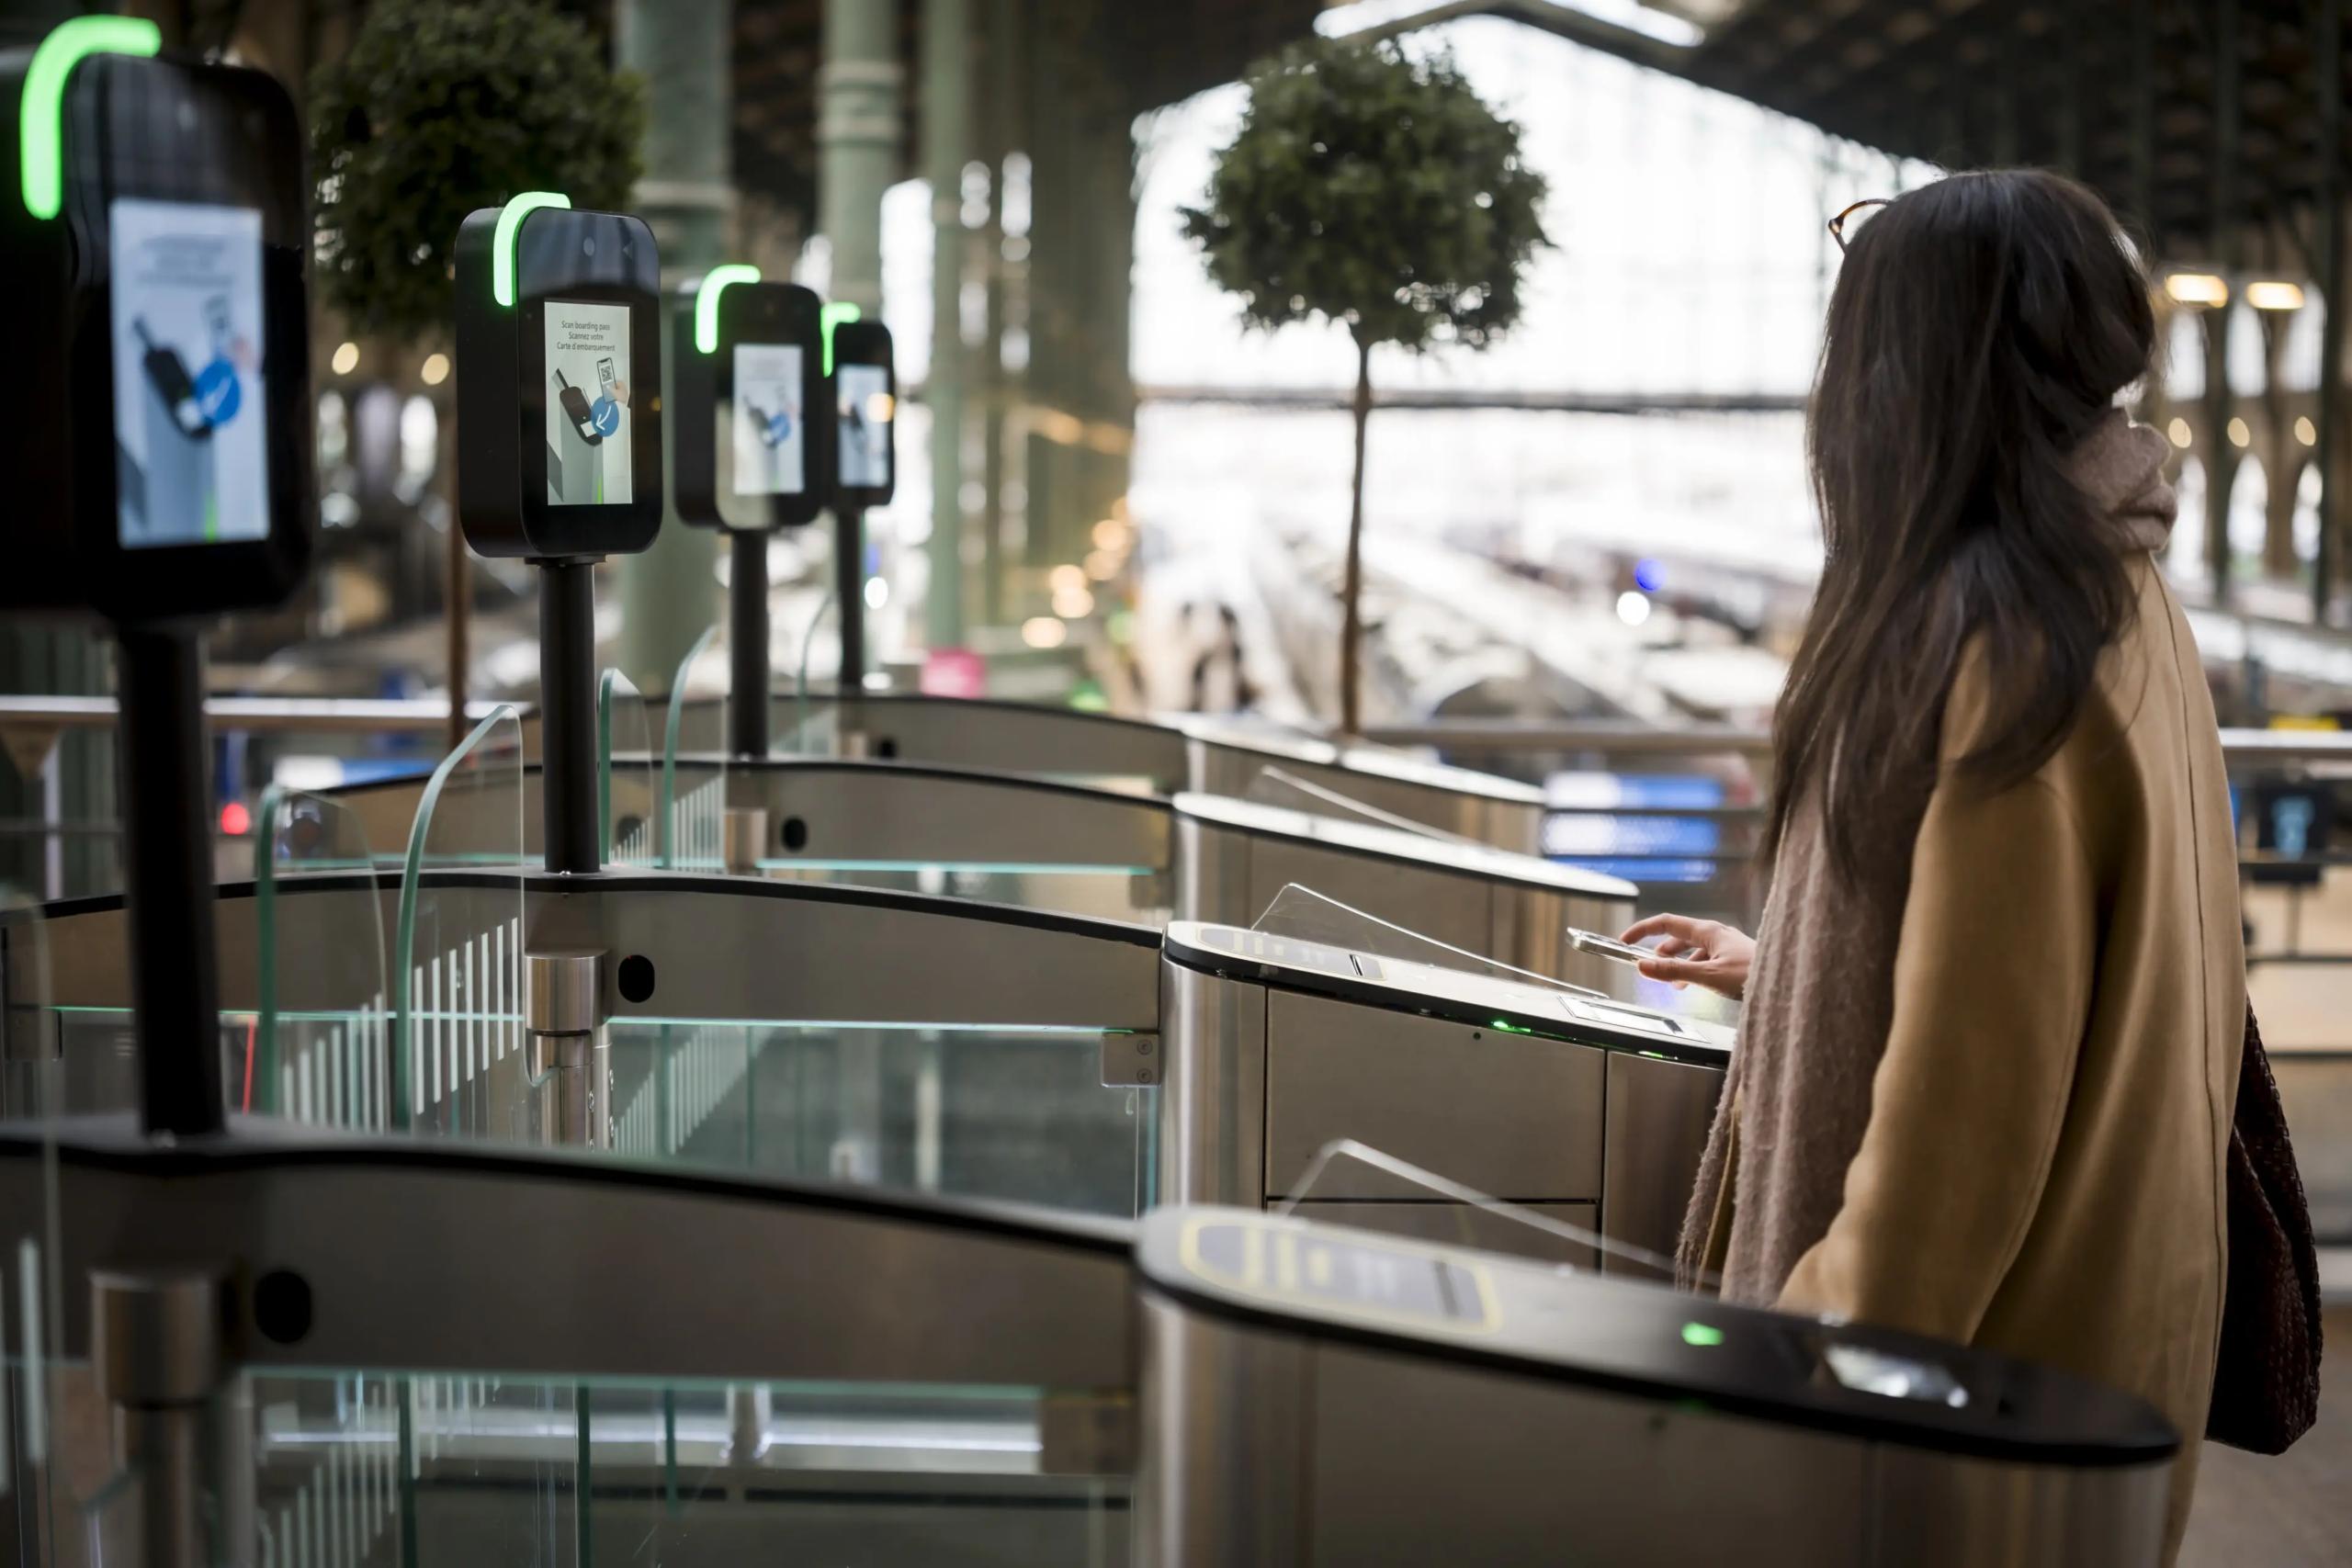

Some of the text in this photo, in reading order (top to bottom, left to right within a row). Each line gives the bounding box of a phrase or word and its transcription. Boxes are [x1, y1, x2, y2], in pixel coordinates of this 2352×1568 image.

[561, 321, 610, 332] Scan boarding pass
[569, 332, 590, 340] Scannez
[557, 342, 616, 353] Carte d'embarquement
